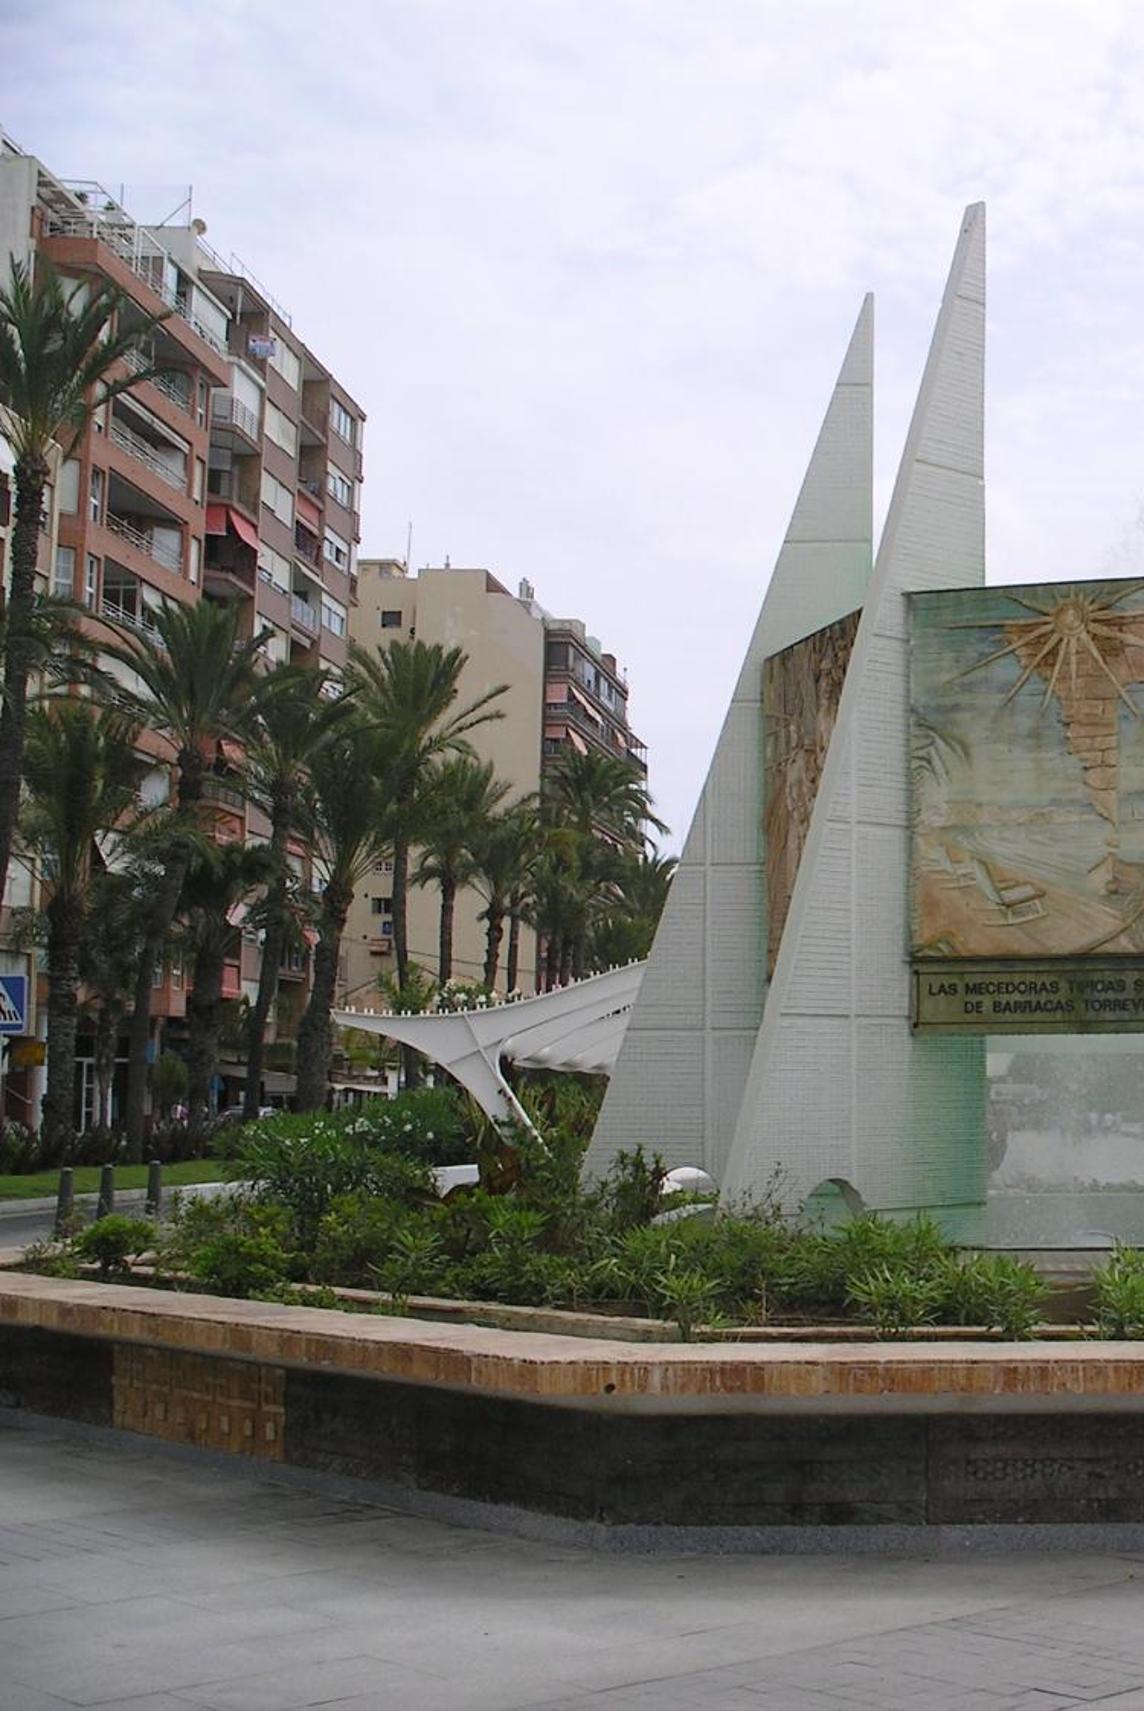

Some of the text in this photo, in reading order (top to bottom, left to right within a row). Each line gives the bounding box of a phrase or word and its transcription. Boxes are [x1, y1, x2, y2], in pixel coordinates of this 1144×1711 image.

[928, 982, 958, 996] LAS
[965, 980, 1059, 996] MECEDORAS
[964, 1001, 983, 1014] DE
[993, 999, 1074, 1014] BARRACAS
